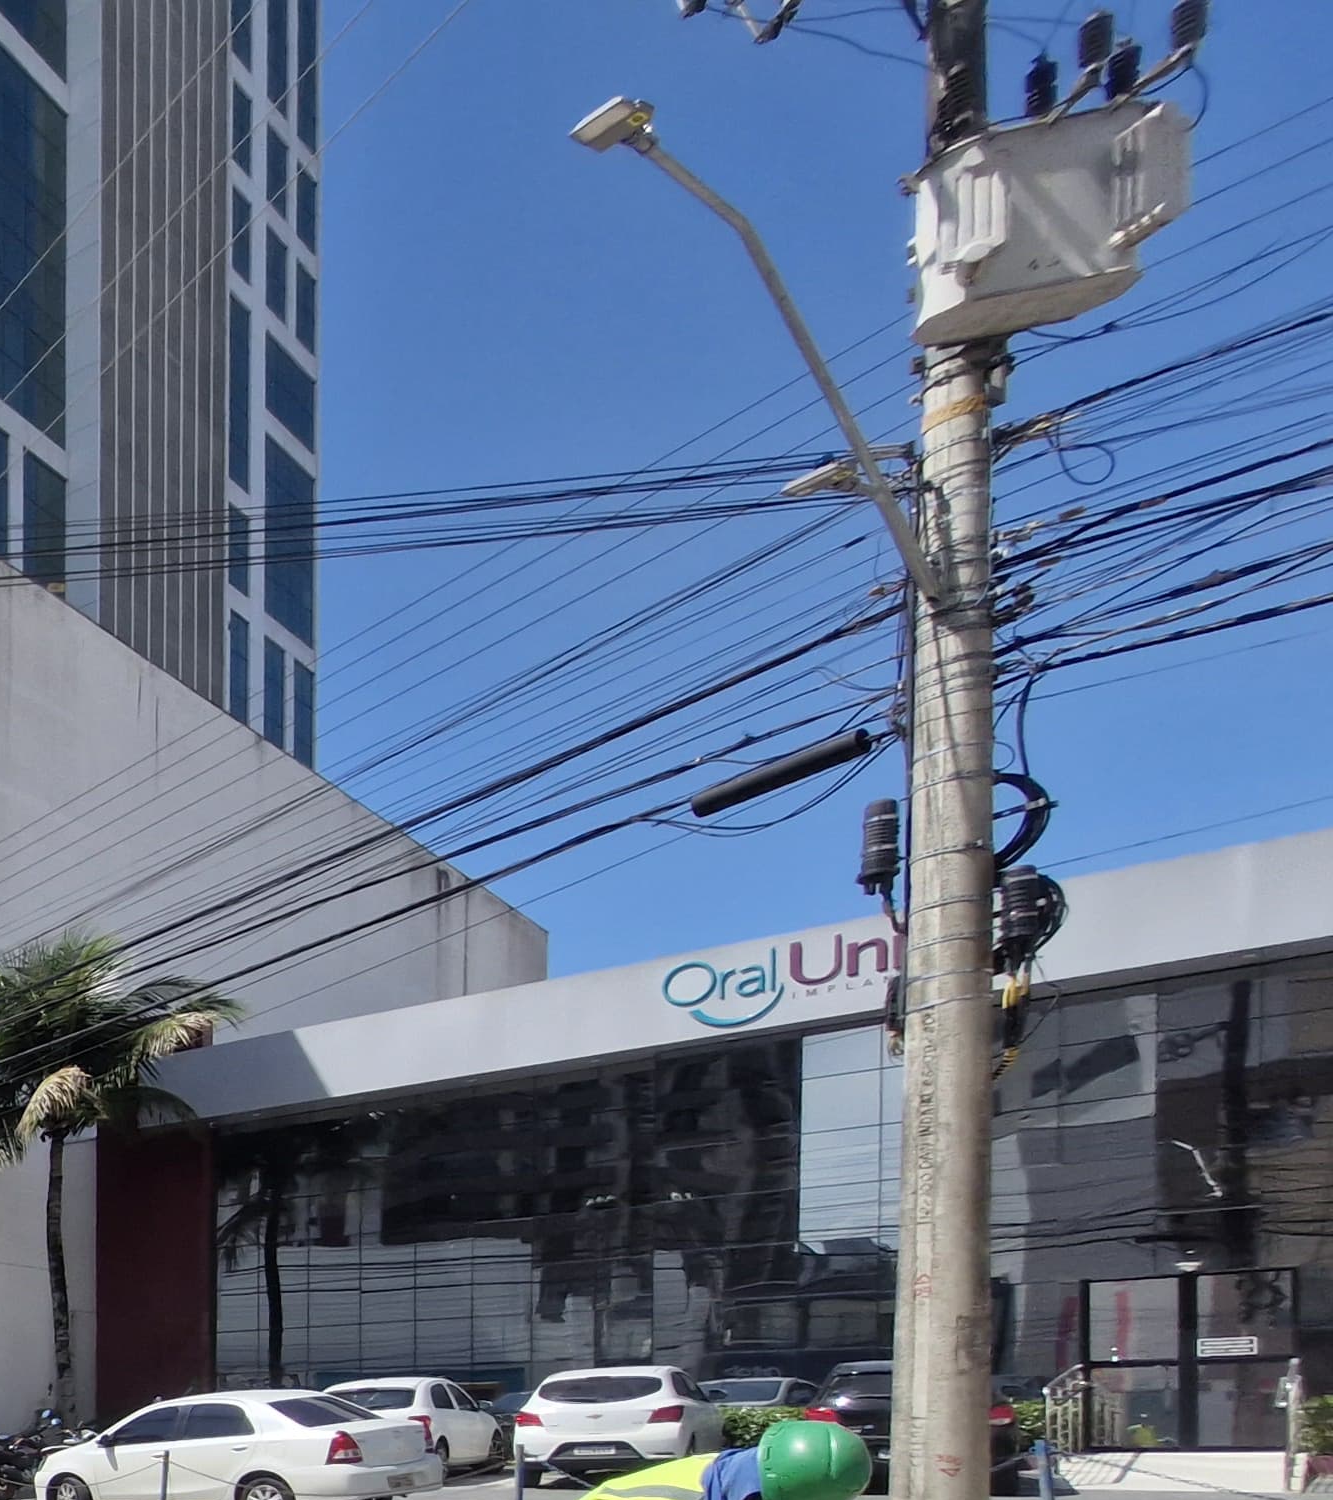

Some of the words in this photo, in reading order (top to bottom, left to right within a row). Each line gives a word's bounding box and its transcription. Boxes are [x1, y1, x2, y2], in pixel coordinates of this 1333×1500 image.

[662, 947, 779, 1009] Oral
[790, 934, 903, 986] Uni
[792, 976, 891, 999] IMPLA
